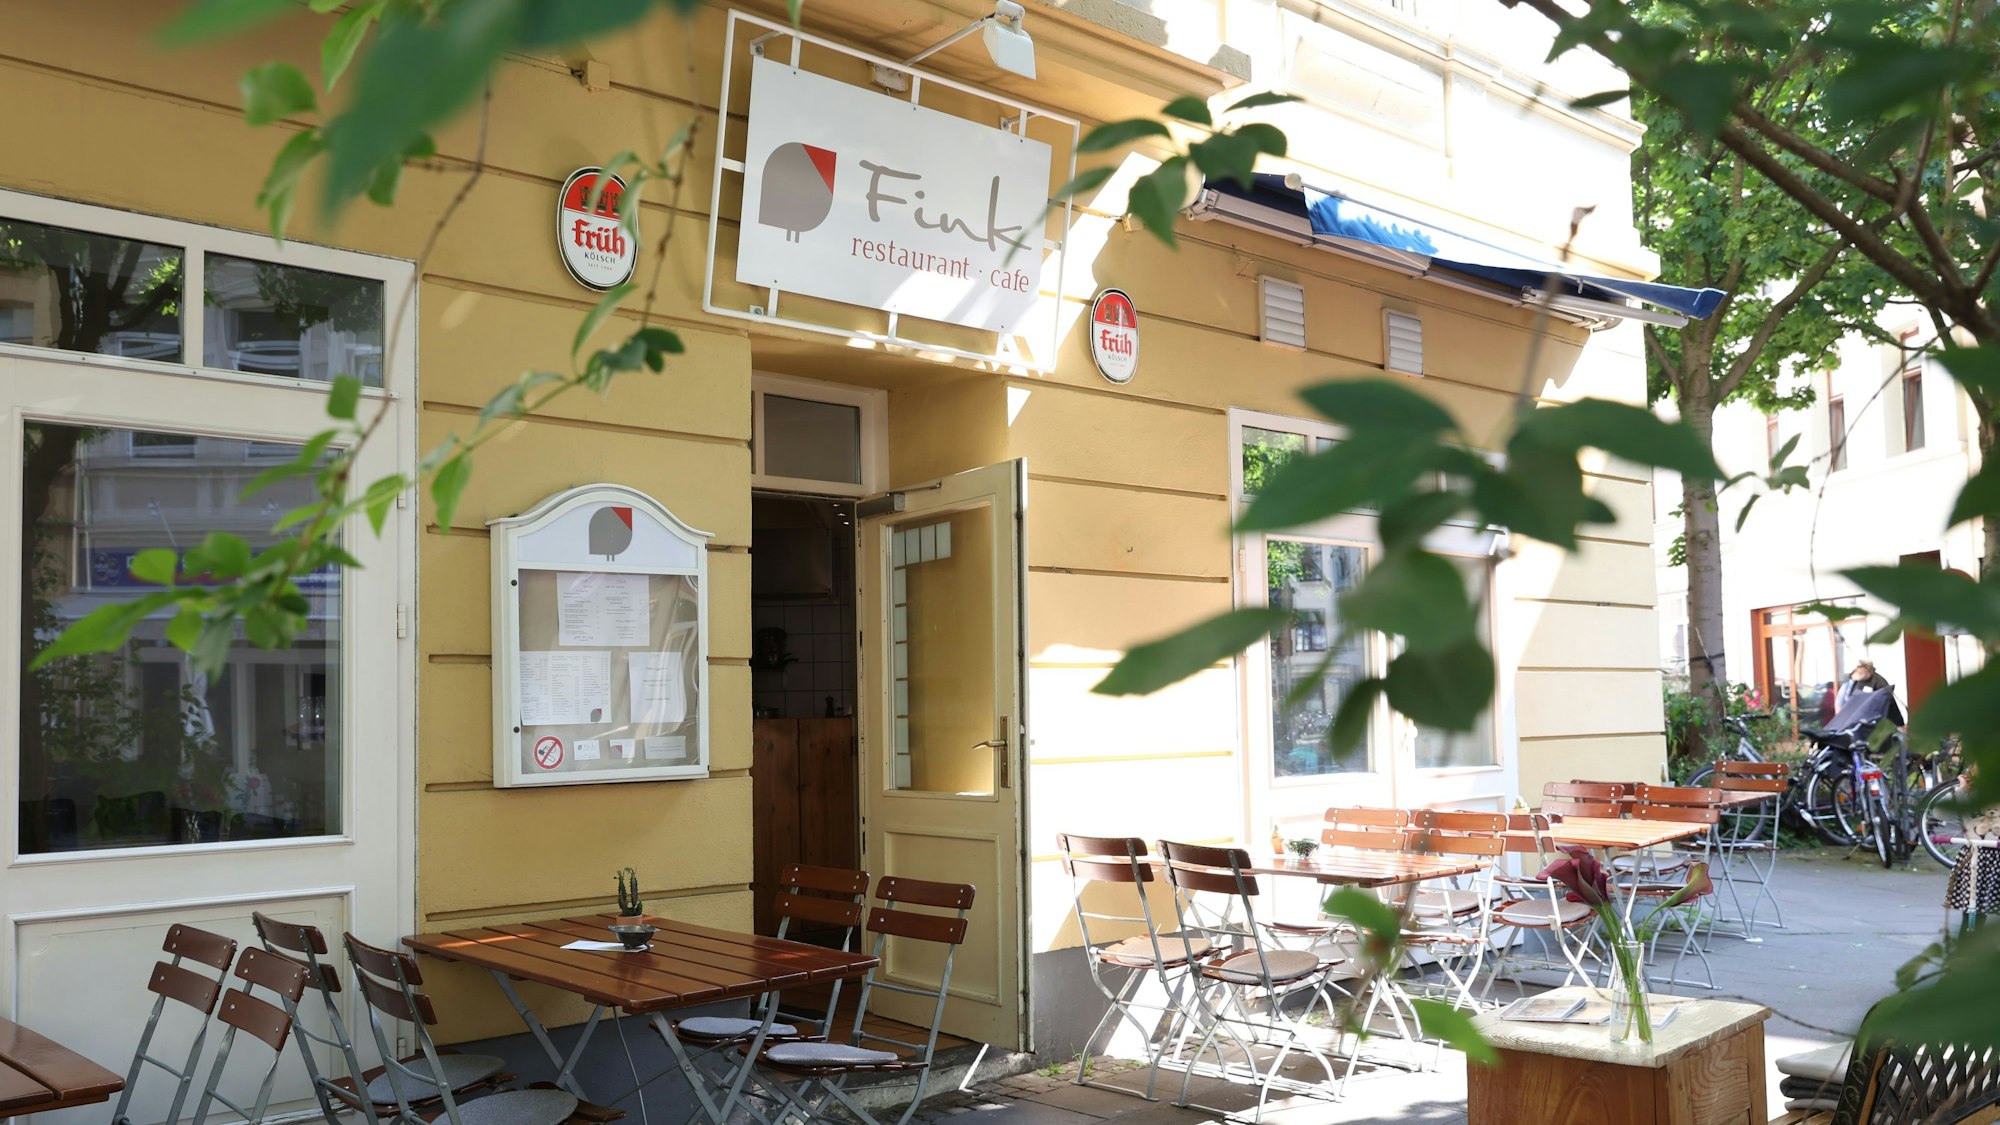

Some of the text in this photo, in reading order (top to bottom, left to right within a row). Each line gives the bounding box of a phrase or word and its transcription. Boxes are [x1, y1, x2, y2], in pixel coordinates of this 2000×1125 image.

[859, 159, 1032, 252] Fink
[584, 251, 616, 264] KÖLSCH
[851, 237, 1029, 293] restaurant cafe
